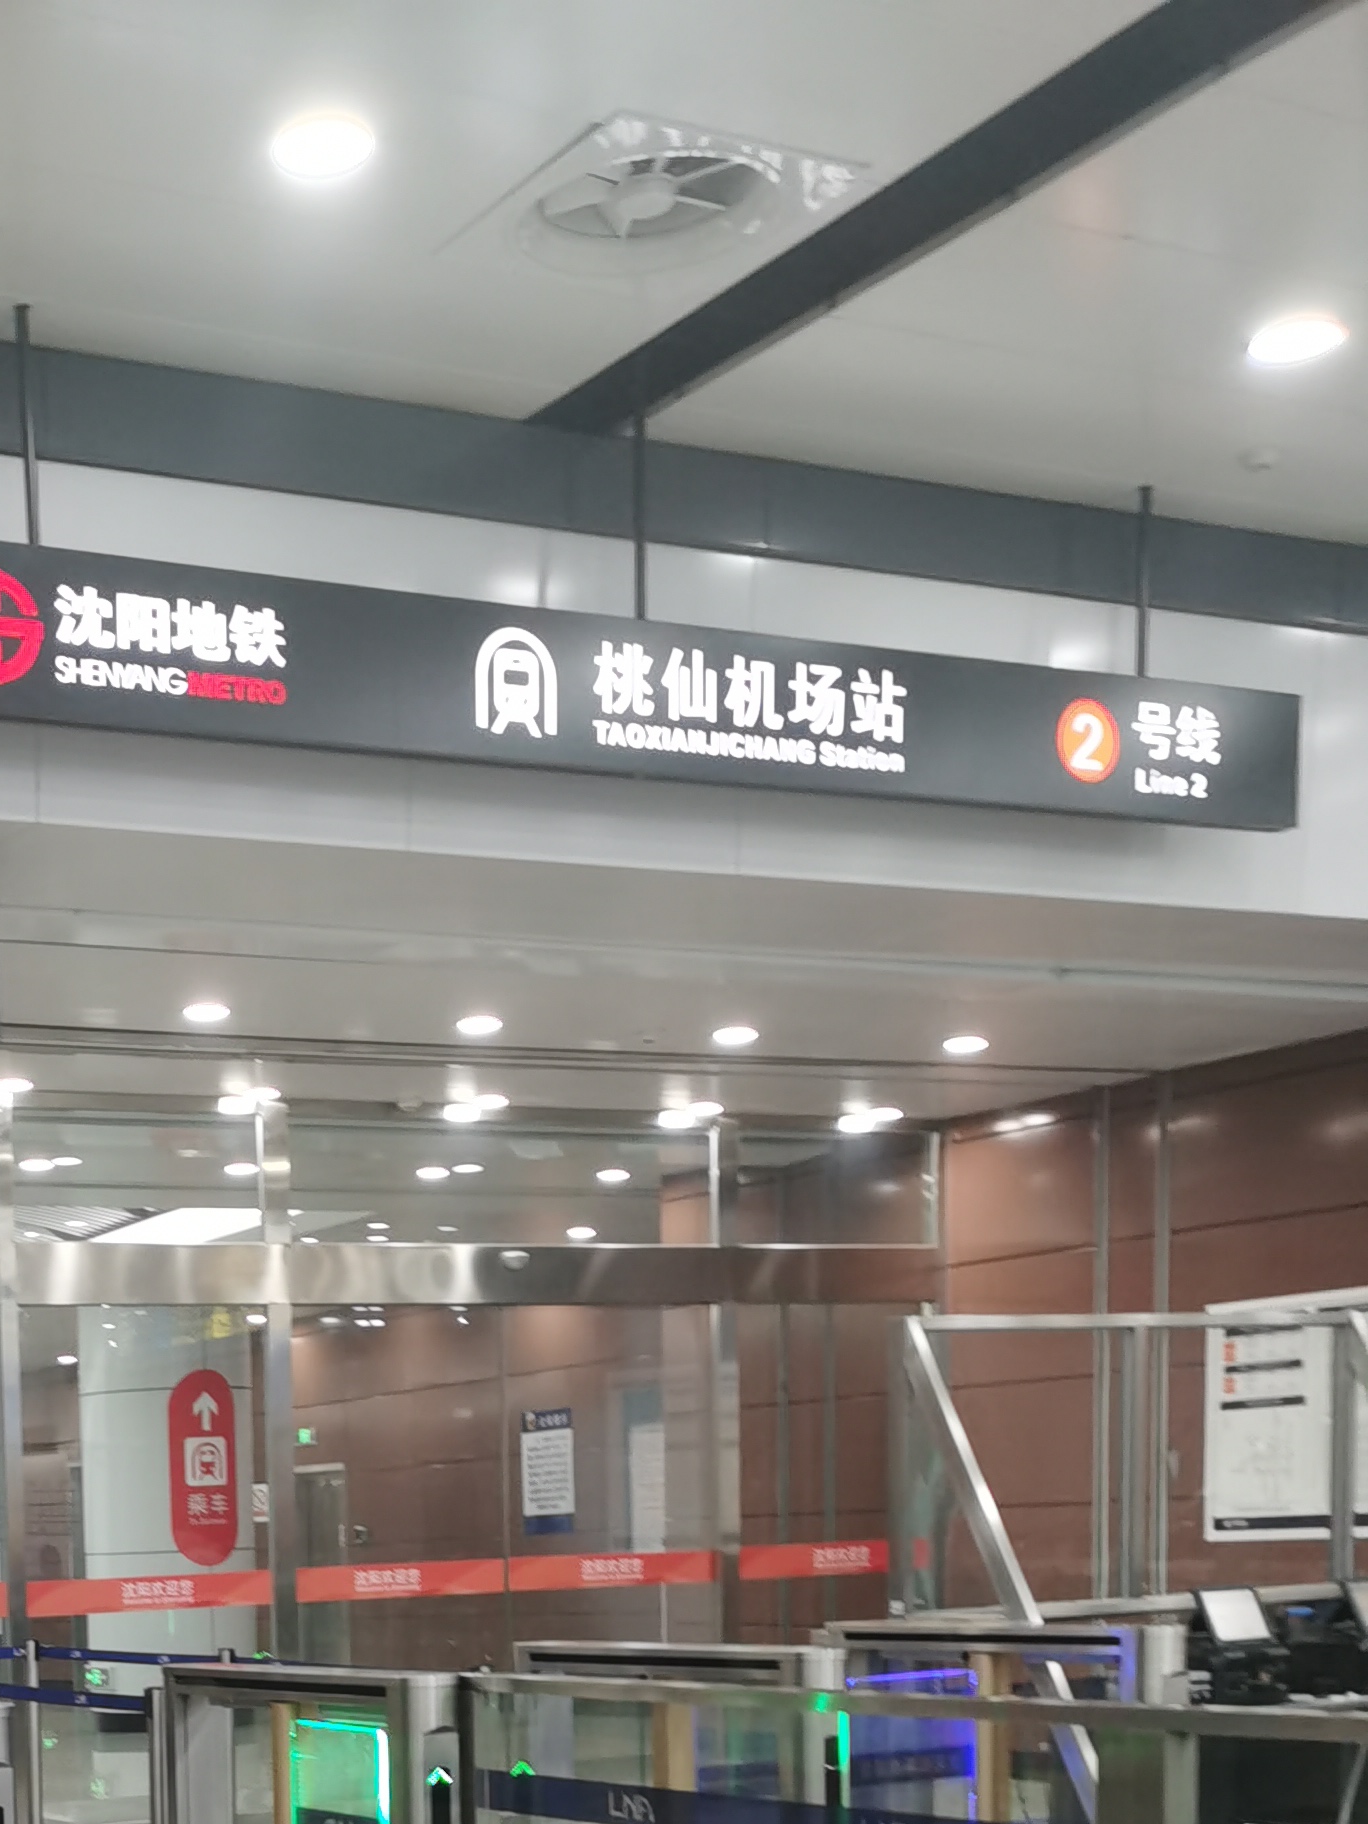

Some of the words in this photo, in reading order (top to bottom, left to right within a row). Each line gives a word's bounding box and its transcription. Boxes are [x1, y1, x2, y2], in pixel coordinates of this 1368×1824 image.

[53, 583, 287, 668] 沈阳地铁
[54, 655, 188, 695] SHENYANG
[187, 670, 287, 705] METRO
[593, 640, 908, 743] 桃仙机场站
[592, 719, 817, 765] TAOXIANJICHANG
[819, 740, 906, 773] Station
[1070, 712, 1104, 771] 2
[1132, 701, 1222, 765] 号线
[1134, 767, 1188, 796] Line
[1190, 772, 1208, 798] 2
